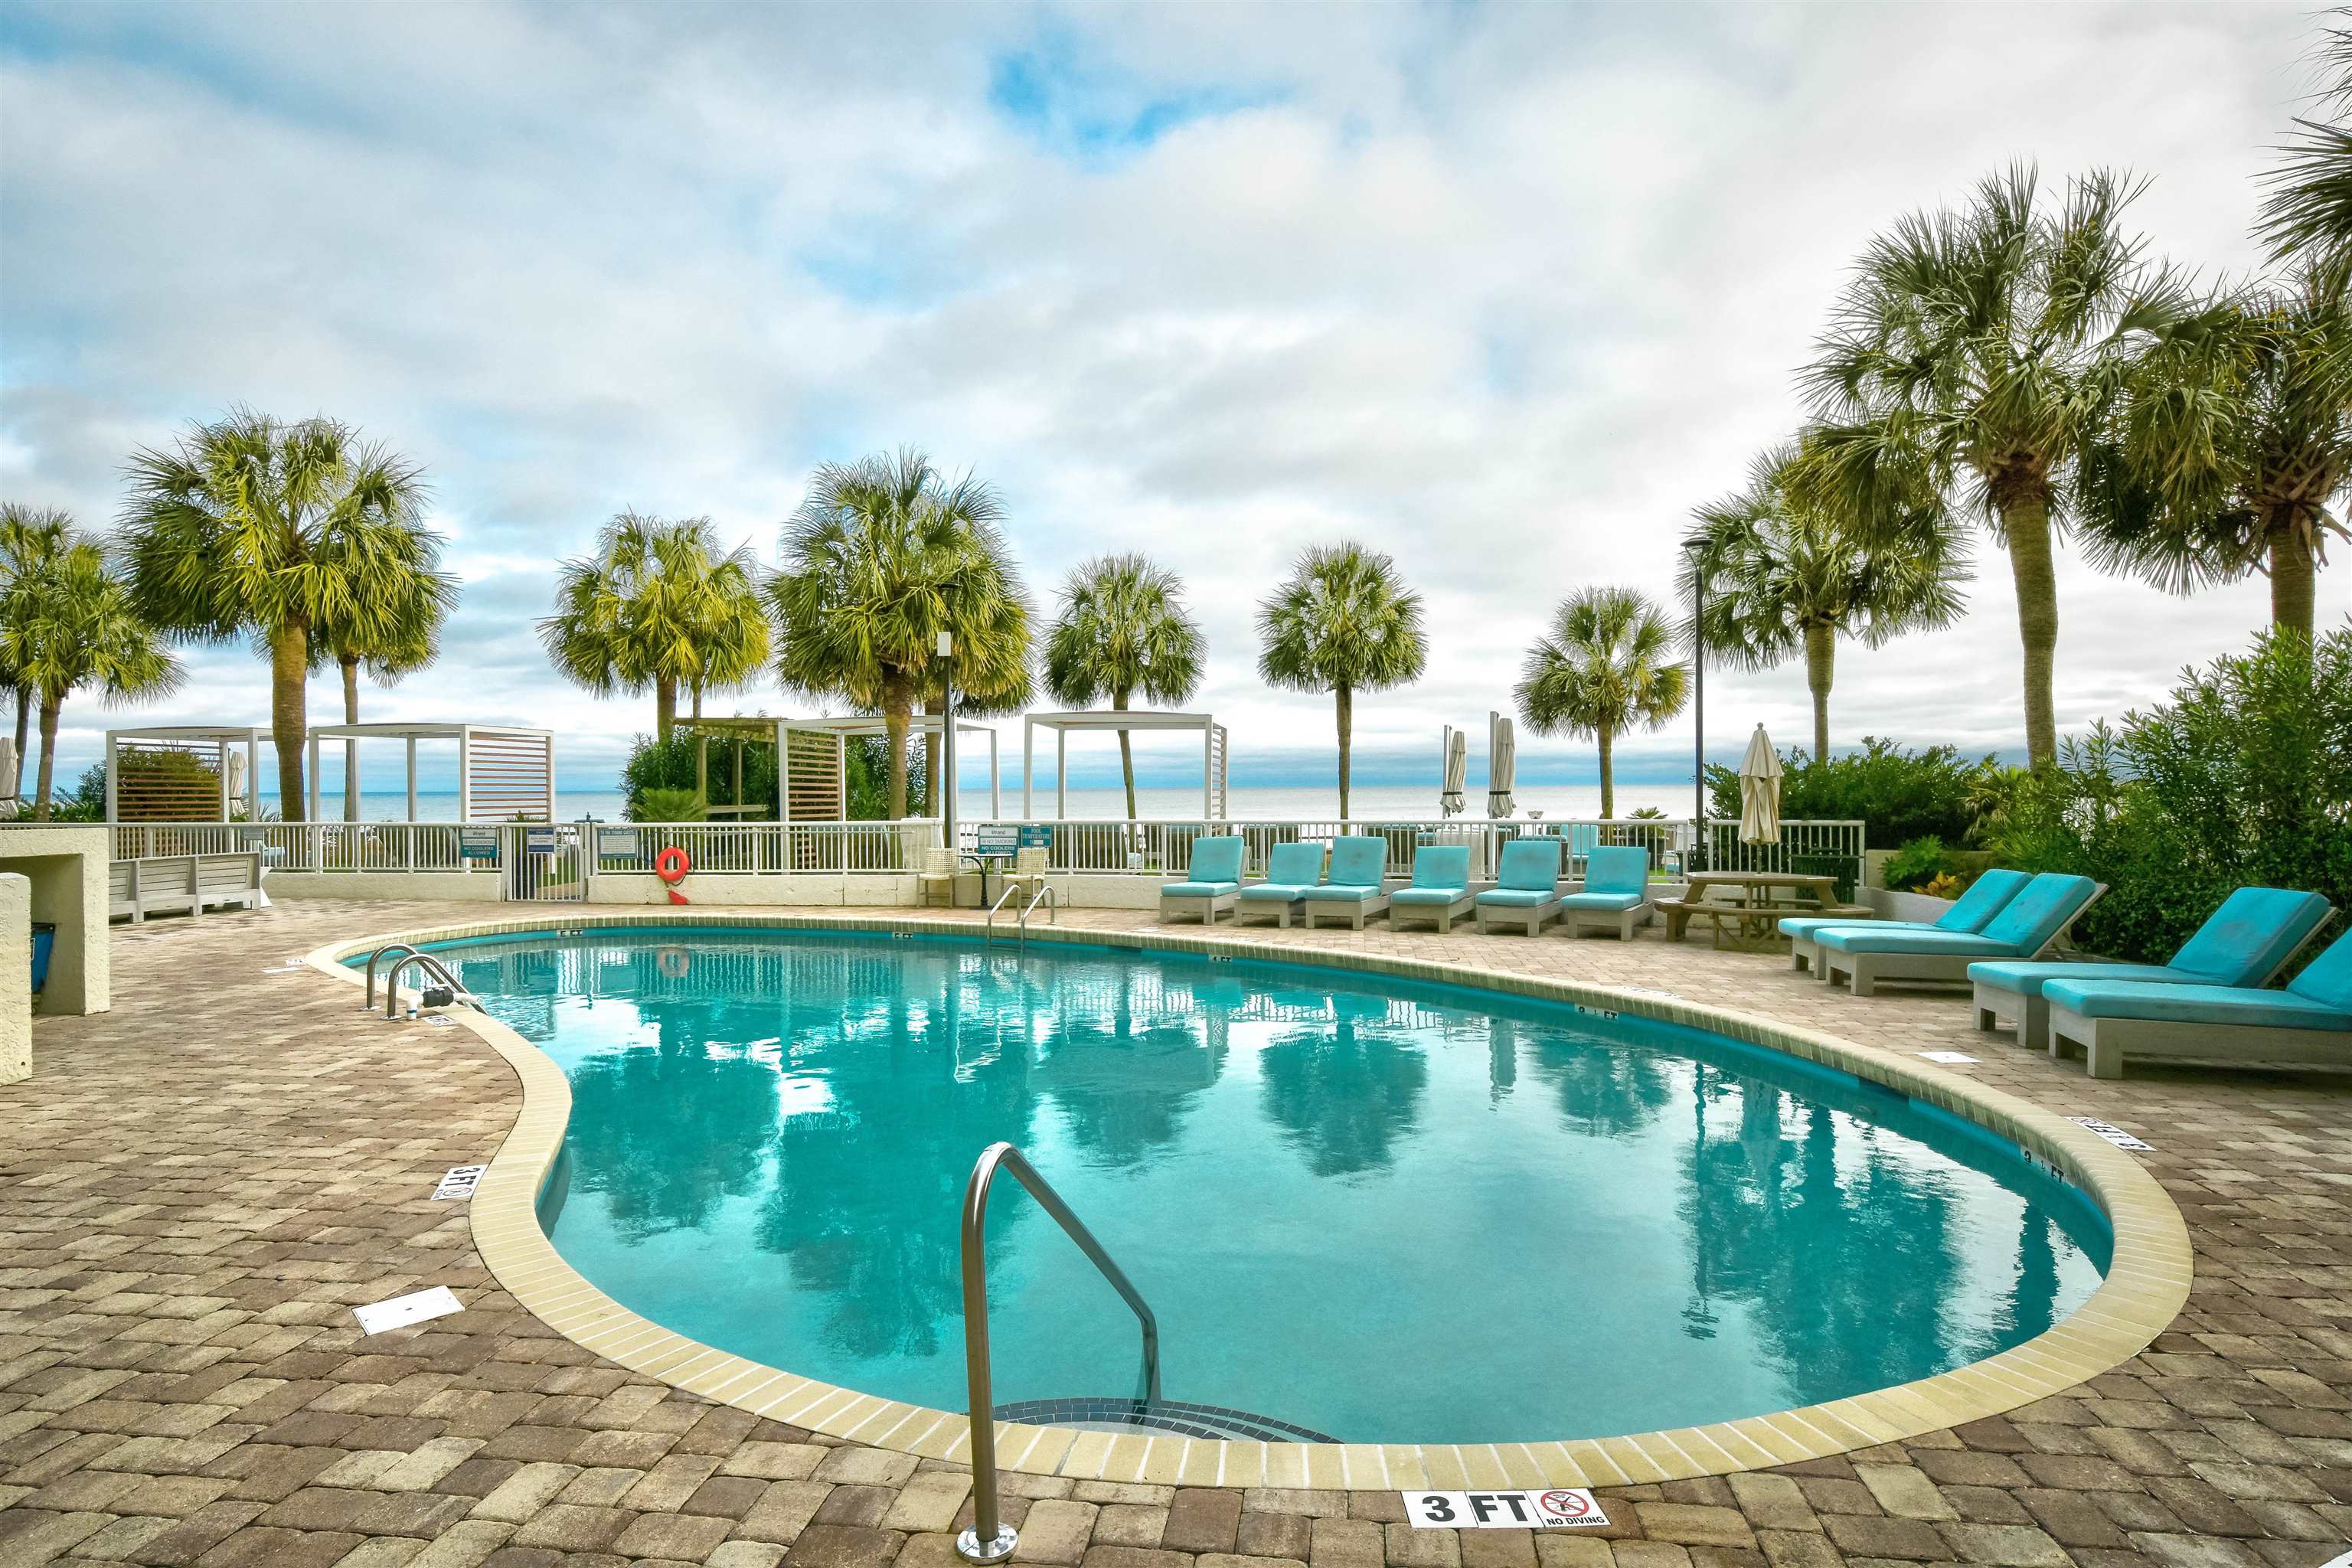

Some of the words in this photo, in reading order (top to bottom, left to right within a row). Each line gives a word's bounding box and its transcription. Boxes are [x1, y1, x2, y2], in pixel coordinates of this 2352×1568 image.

[445, 1175, 476, 1187] FT
[1422, 1495, 1455, 1522] 3
[1468, 1495, 1528, 1522] FT
[1565, 1517, 1606, 1525] DIVING
